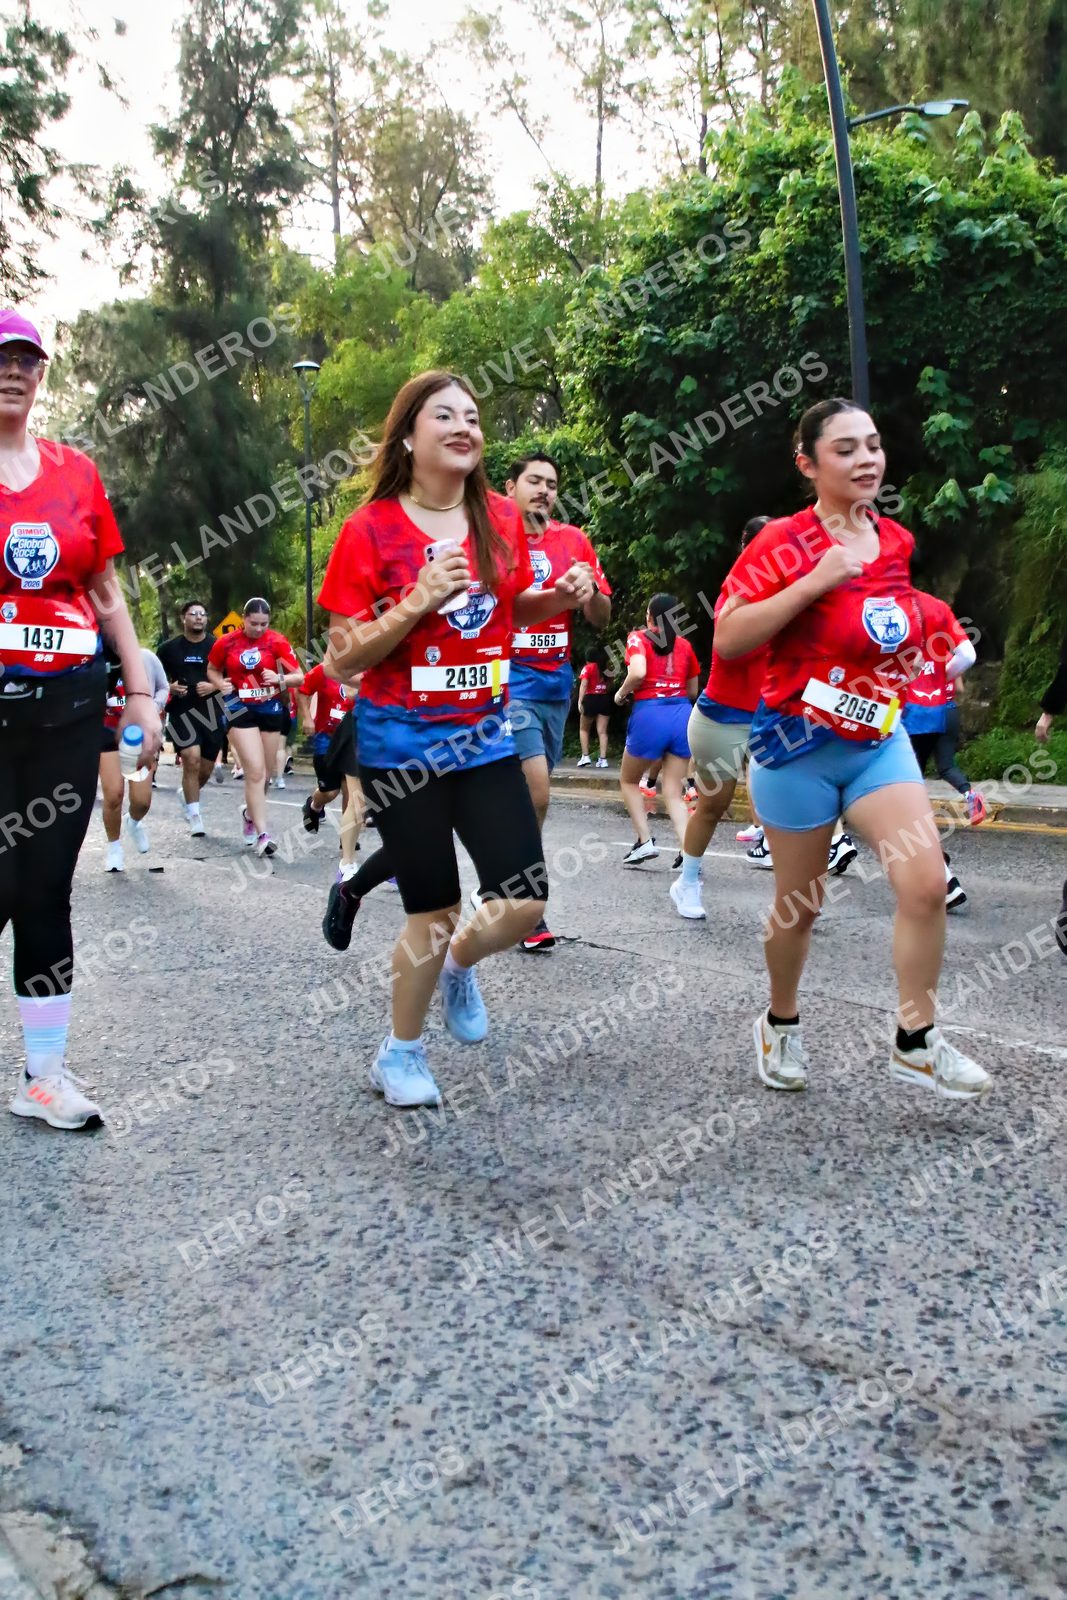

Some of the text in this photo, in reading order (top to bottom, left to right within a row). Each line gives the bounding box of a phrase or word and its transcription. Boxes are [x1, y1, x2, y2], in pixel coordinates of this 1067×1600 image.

[12, 547, 36, 558] Race
[18, 539, 46, 549] Global
[22, 627, 64, 650] 1437
[530, 634, 556, 647] 3563
[446, 665, 488, 688] 2438
[834, 693, 878, 723] 2056
